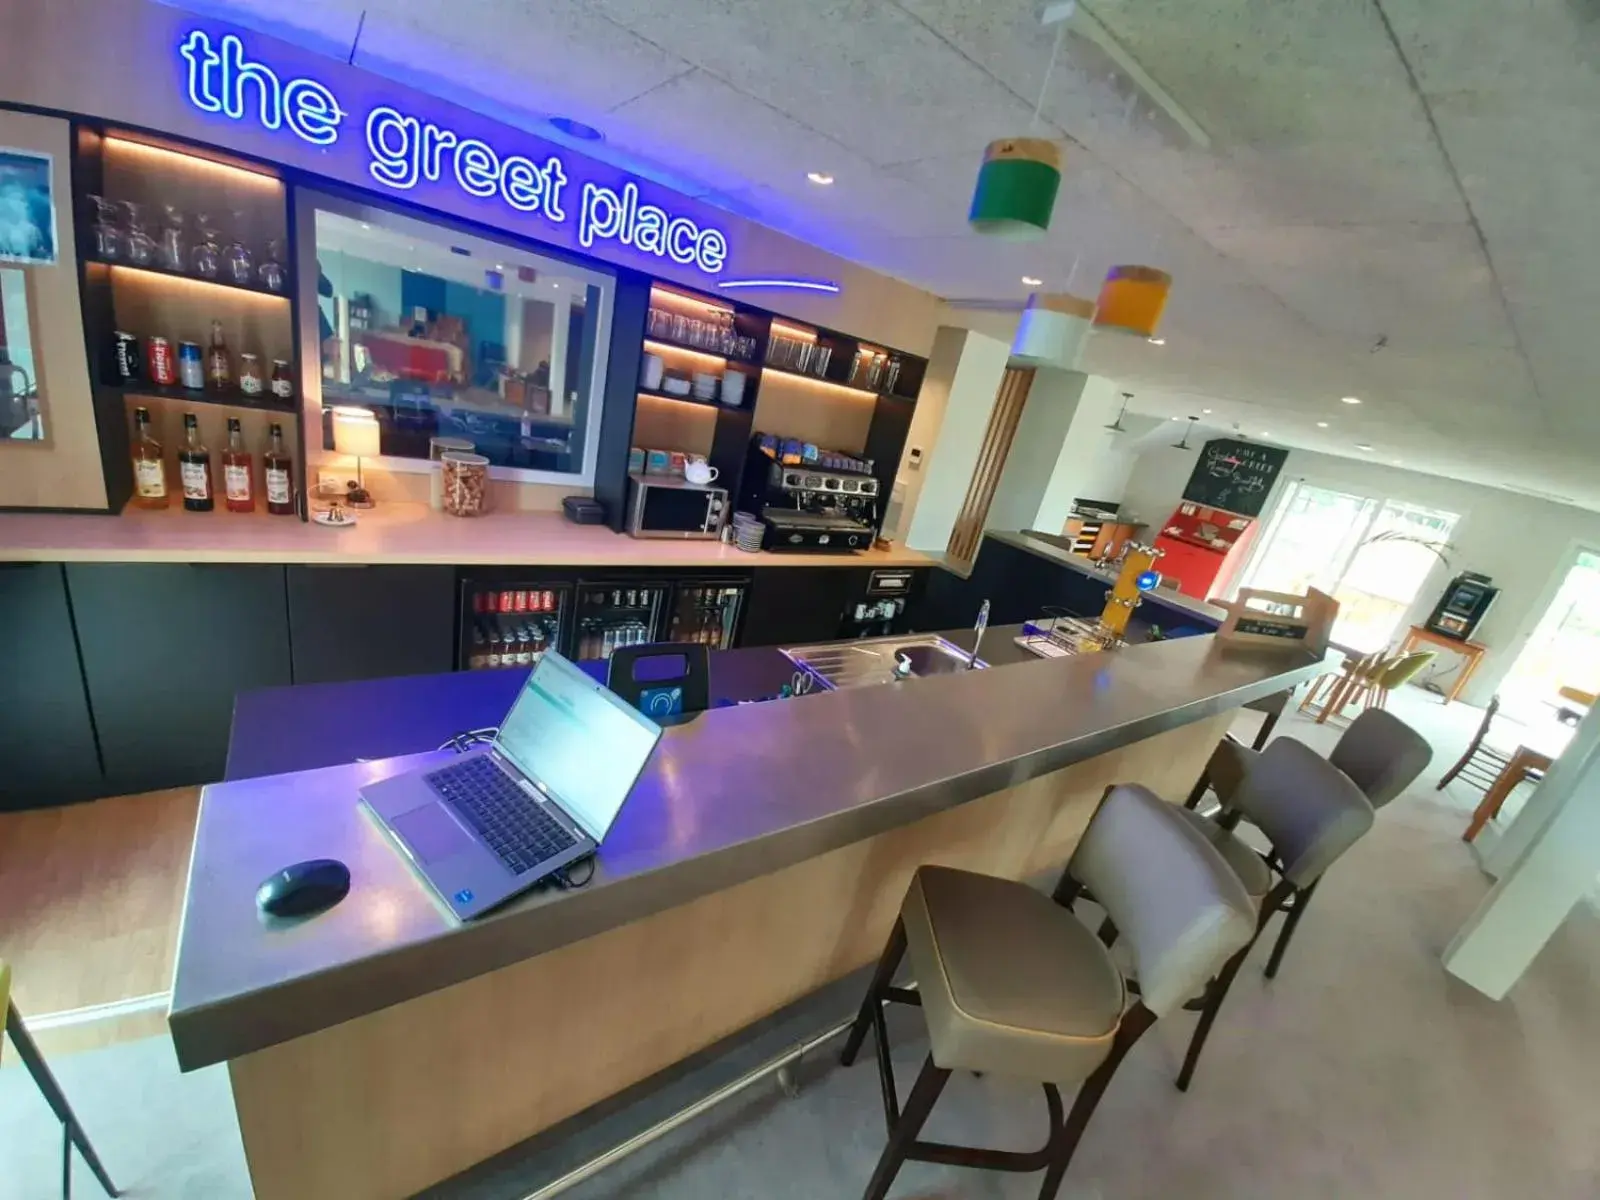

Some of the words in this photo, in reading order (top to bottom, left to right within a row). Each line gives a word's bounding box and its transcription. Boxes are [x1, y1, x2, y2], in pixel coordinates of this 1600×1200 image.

[180, 30, 341, 145] the
[366, 107, 567, 222] greet
[579, 182, 727, 273] place
